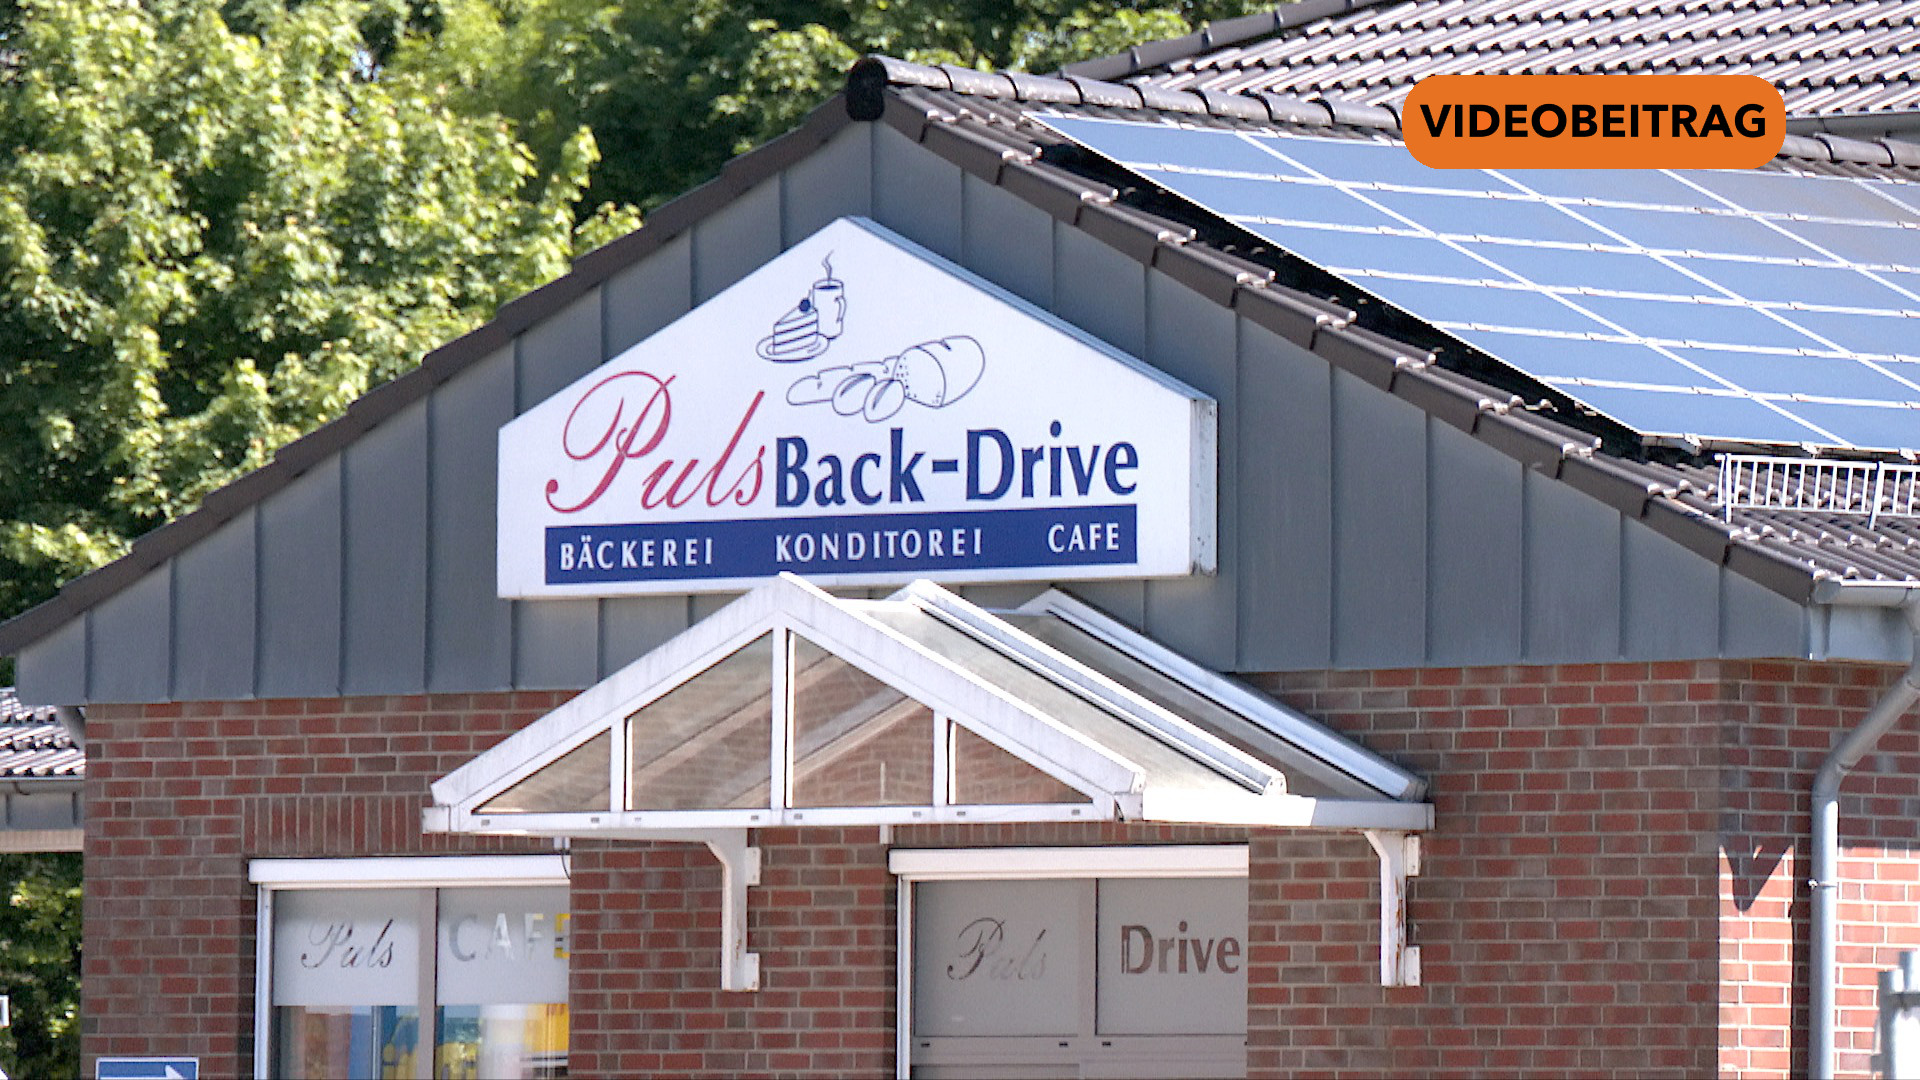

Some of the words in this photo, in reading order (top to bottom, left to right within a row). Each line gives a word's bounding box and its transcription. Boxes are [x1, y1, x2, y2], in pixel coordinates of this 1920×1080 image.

[545, 370, 765, 514] Puls
[775, 419, 1139, 508] Back-Drive
[560, 534, 713, 571] BÄCKEREI
[775, 528, 983, 563] KONDITOREI
[1047, 522, 1120, 553] CAFE
[1121, 920, 1241, 974] Drive
